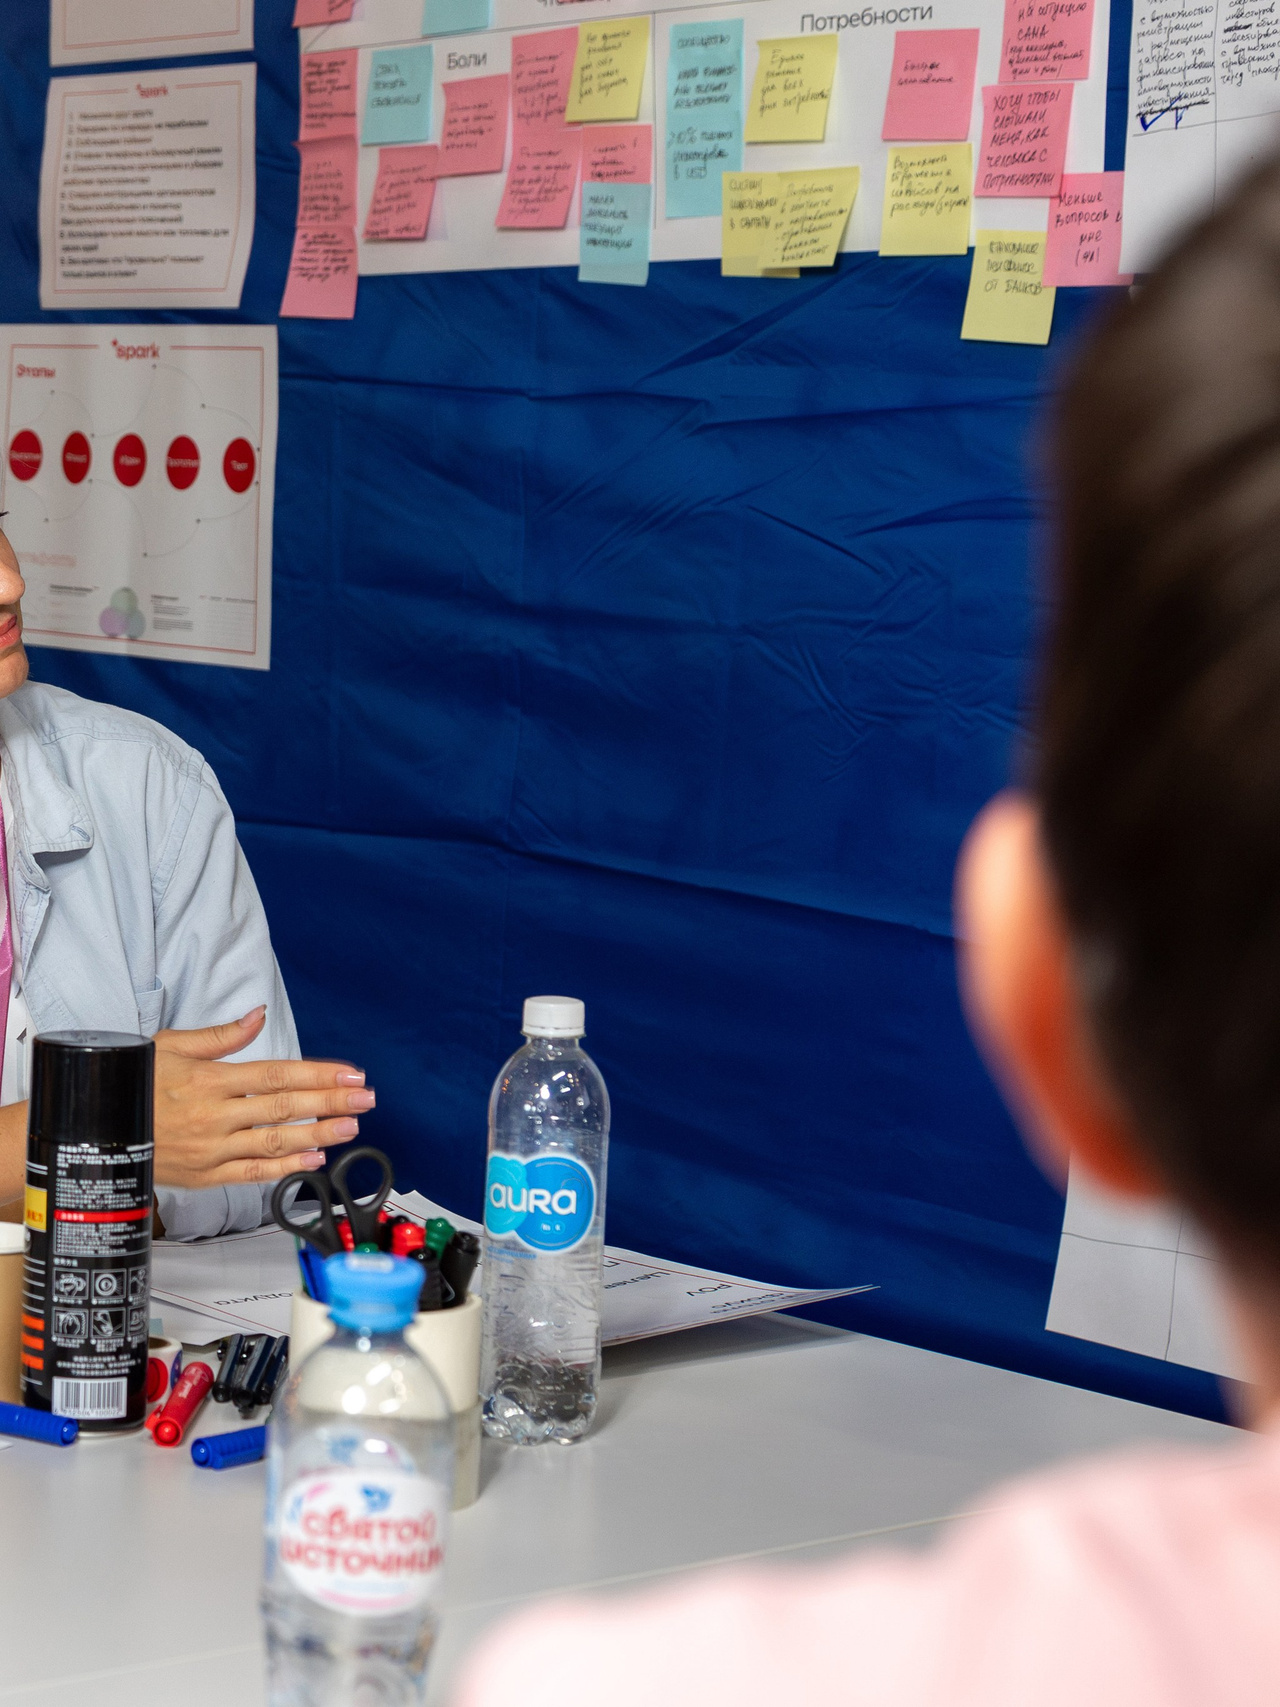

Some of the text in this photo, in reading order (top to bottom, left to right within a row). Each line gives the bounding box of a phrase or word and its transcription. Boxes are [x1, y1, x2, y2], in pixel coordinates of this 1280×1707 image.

[801, 5, 933, 32] Потребности
[447, 52, 487, 70] Боли
[992, 93, 1024, 114] ХОЧУ
[1058, 191, 1104, 207] Меньше
[1079, 229, 1103, 246] мне
[115, 342, 159, 361] spark
[489, 1182, 578, 1216] aura
